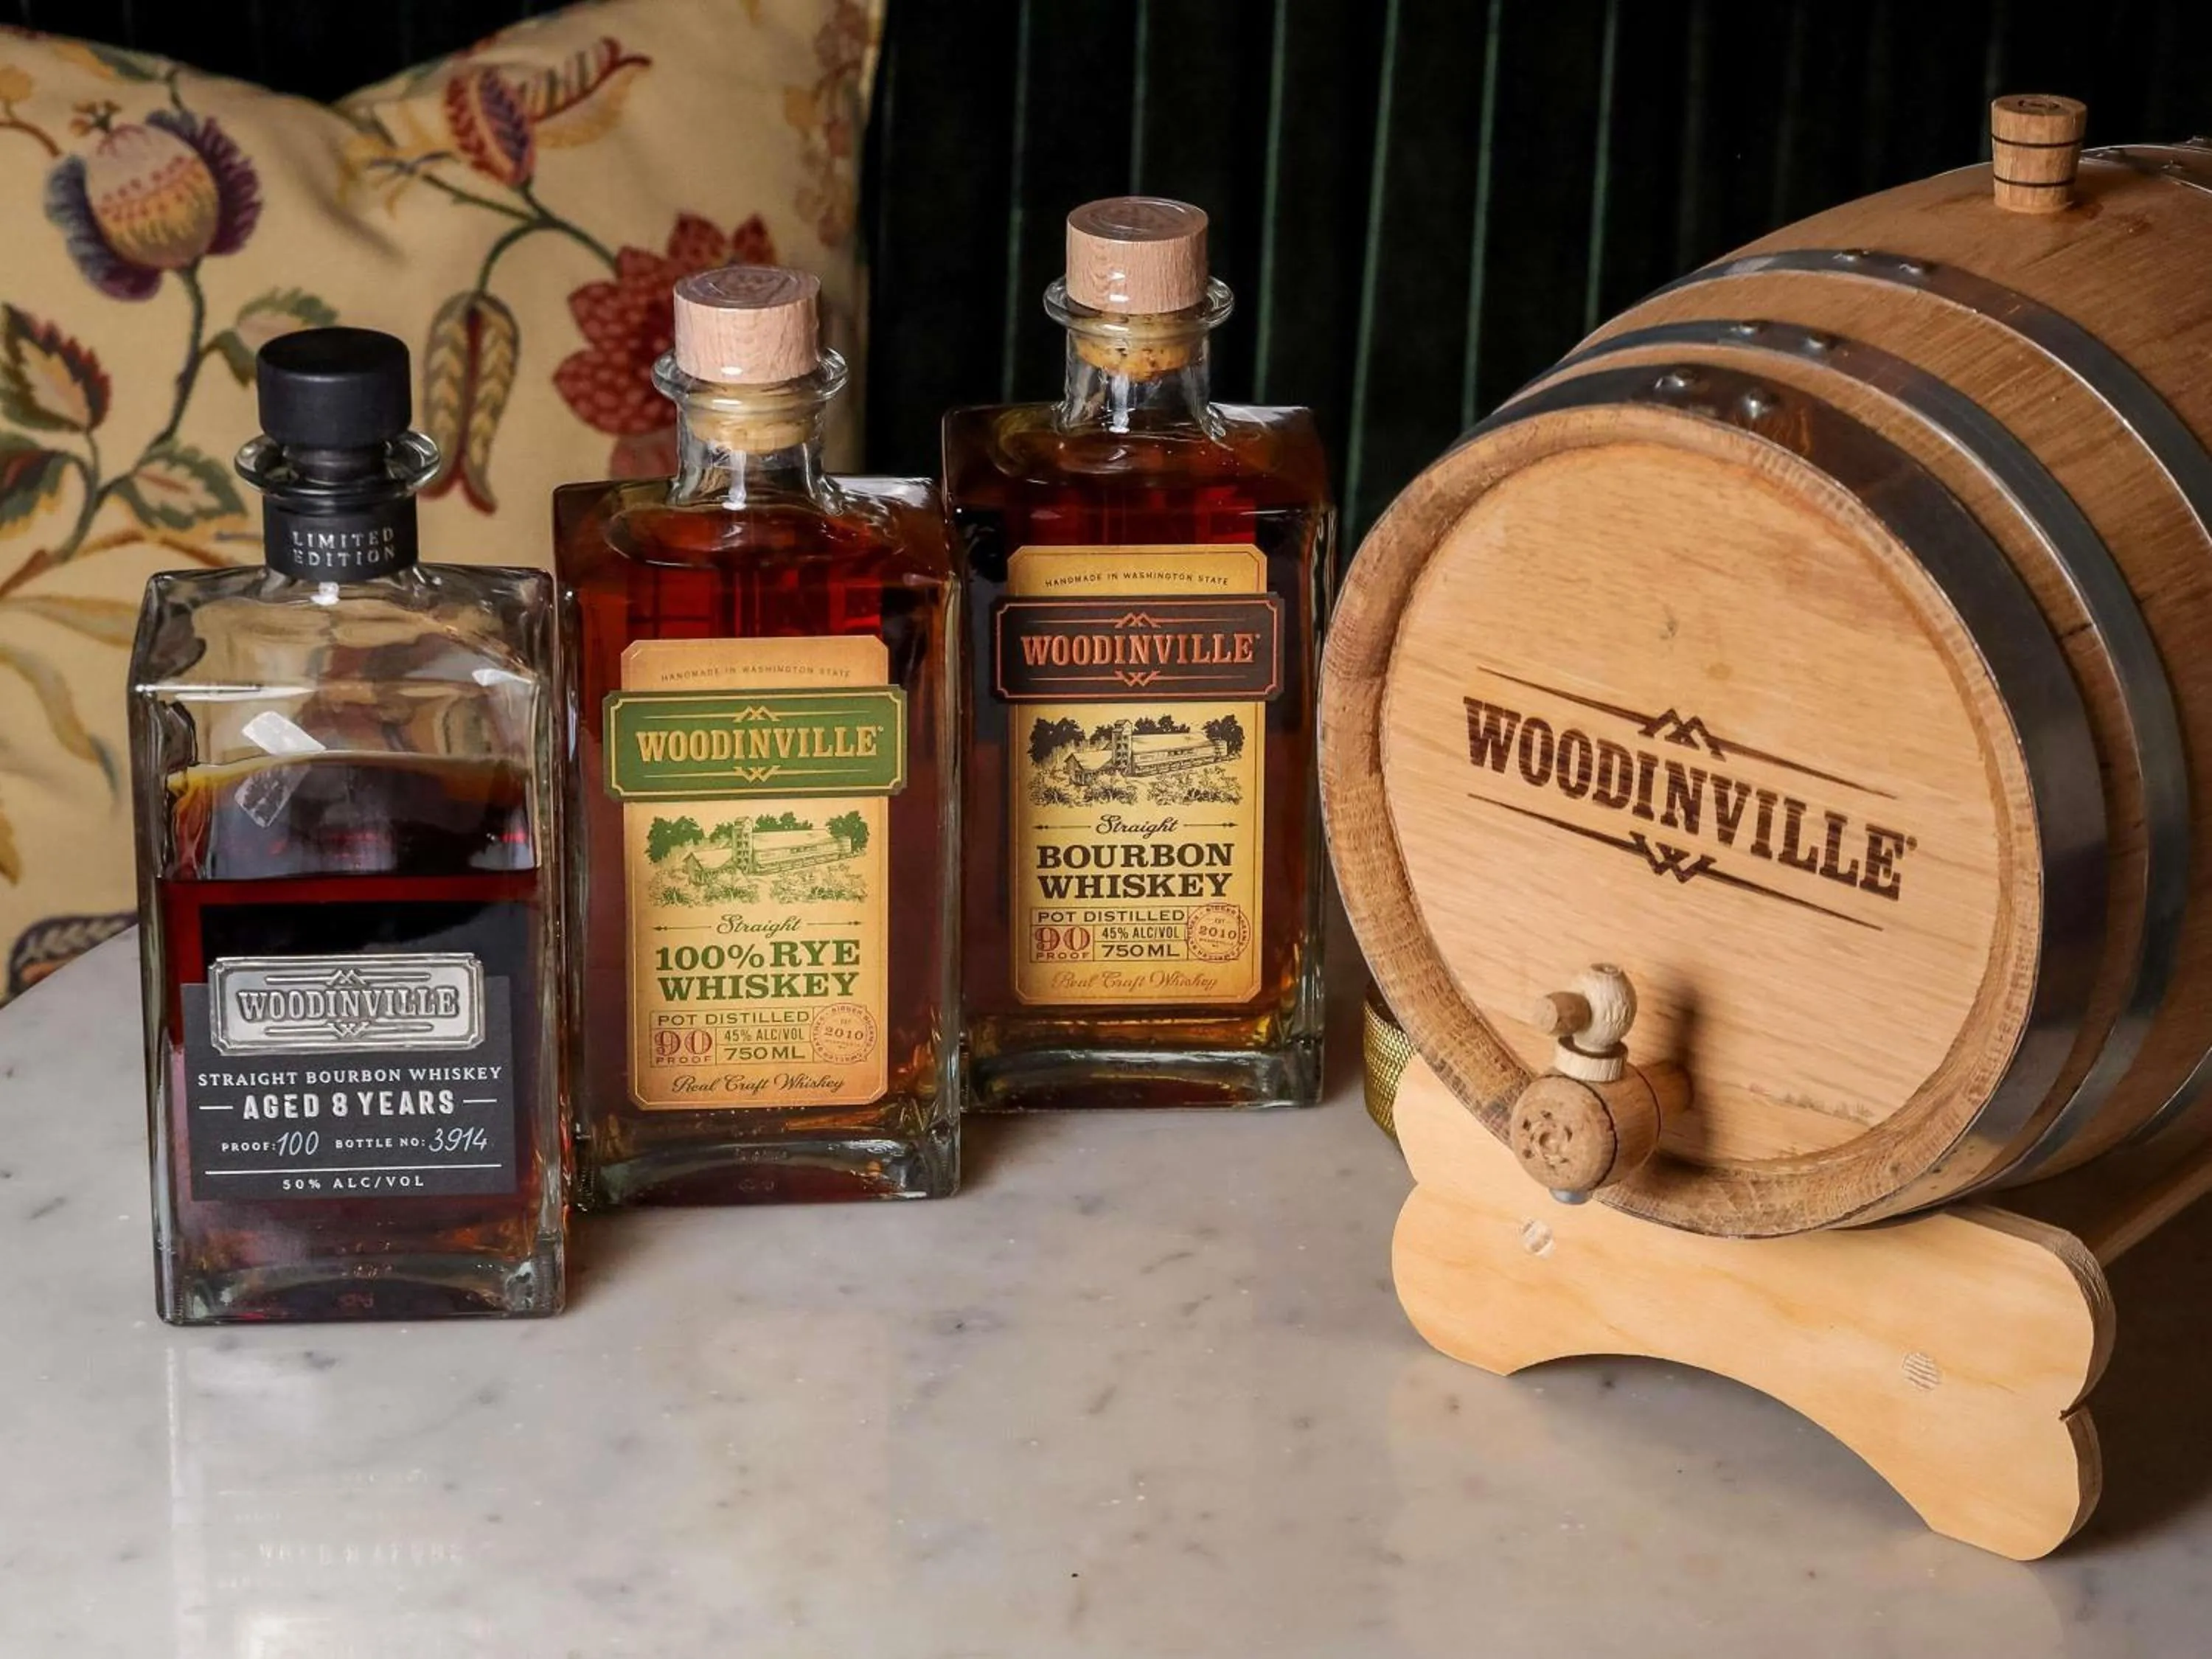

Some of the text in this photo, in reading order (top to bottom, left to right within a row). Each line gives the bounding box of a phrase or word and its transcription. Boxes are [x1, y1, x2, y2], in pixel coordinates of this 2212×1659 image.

[293, 527, 394, 549] LIMITED
[293, 547, 394, 567] EDITION
[1046, 571, 1228, 588] HANDMADE IN WASHINGTON STATE
[1020, 633, 1254, 666] WOODINVILLE
[742, 665, 813, 674] WASHINGTON
[820, 667, 850, 678] STATE
[636, 726, 877, 762] WOODINVILLE
[1464, 696, 1904, 901] WOODINVILLE
[1096, 814, 1179, 839] Straight
[1036, 843, 1235, 869] BOURBON
[1037, 872, 1233, 900] WHISKEY
[717, 914, 801, 939] Straight
[1037, 910, 1185, 922] POT DISTILLED
[1034, 927, 1091, 951] 90
[1102, 926, 1180, 939] 45% ALC/VOL
[1199, 925, 1237, 940] 2010
[655, 939, 860, 971] 100% RYE
[657, 971, 860, 1001] WHISKEY
[1051, 970, 1218, 992] Real Craft Whiskey
[237, 987, 461, 1020] WOODINVILLE
[658, 1011, 810, 1026] POT DISTILLED
[654, 1030, 713, 1057] 90
[724, 1027, 804, 1042] 45% ALC/VOL
[824, 1026, 863, 1040] 2010
[656, 1055, 712, 1064] PROOF
[198, 1067, 501, 1086] STRAIGHT BOURBON WHISKEY
[672, 1073, 845, 1096] Real Craft Whiskey
[243, 1091, 454, 1119] AGED 8 YEARS
[276, 1131, 319, 1155] 100
[335, 1127, 487, 1152] BOTTLE NO: 3914
[282, 1176, 424, 1189] 50% ALC/VOL
